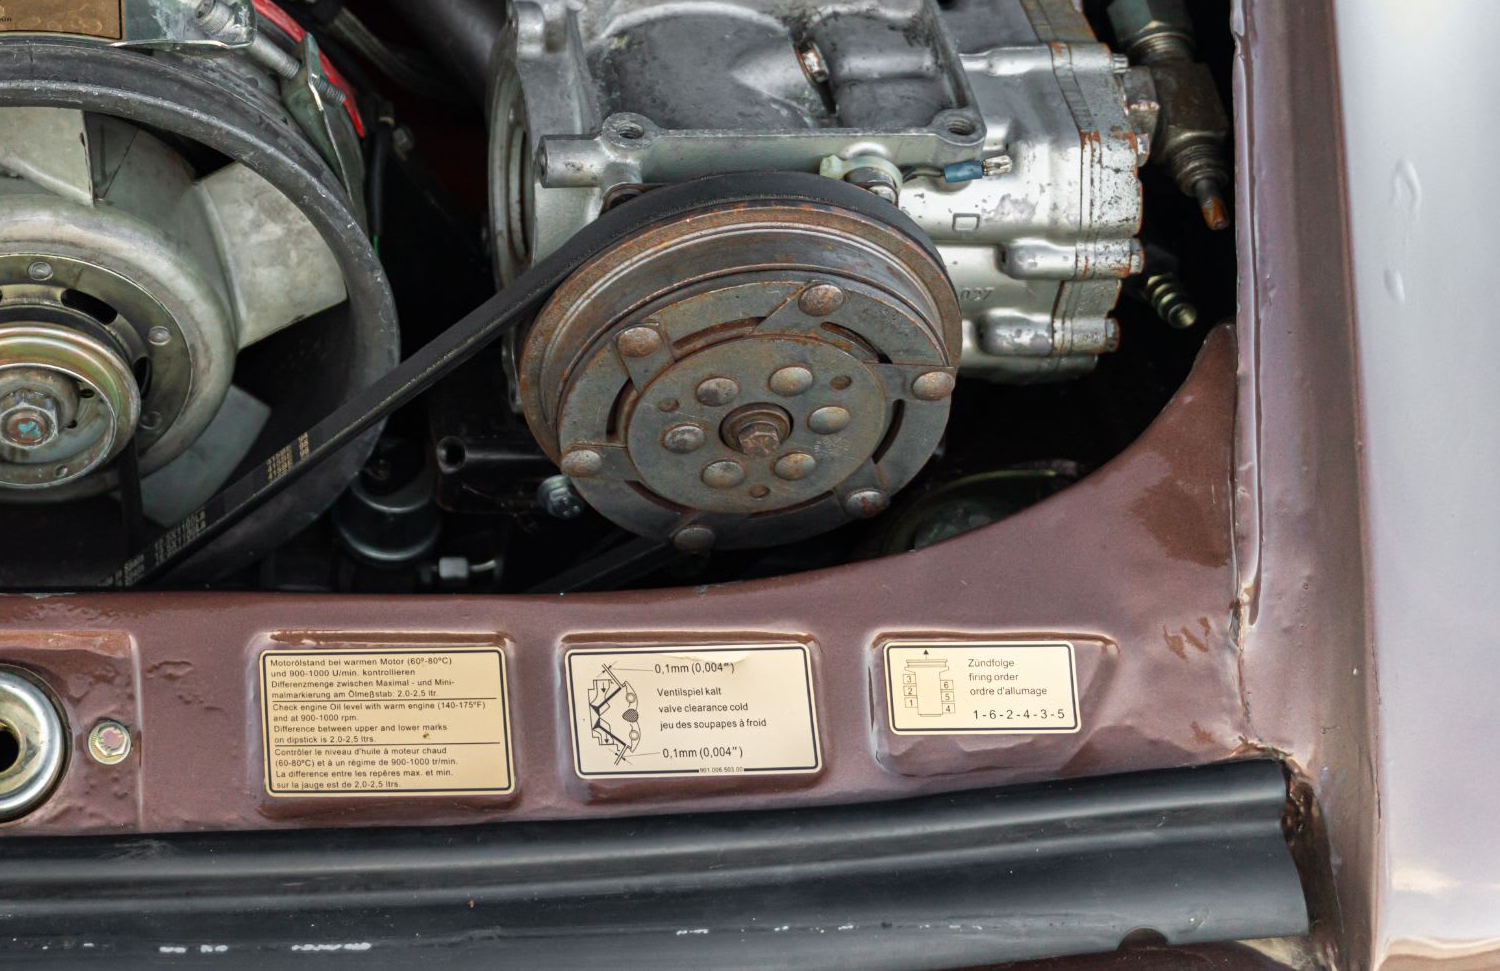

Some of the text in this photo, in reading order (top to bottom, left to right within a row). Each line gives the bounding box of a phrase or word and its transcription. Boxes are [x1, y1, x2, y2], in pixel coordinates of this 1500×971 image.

[270, 659, 326, 667] Motorölstand
[968, 659, 1014, 668] Zündfolge
[290, 669, 330, 677] 900-1000
[363, 668, 415, 676] kontrollieren
[654, 663, 689, 675] 0,1mm
[969, 673, 1018, 682] firing order
[271, 680, 334, 689] Differenzmenge
[337, 679, 373, 687] zwischen
[376, 679, 409, 687] Maximal
[417, 679, 433, 687] und
[435, 678, 455, 686] Mini-
[272, 690, 330, 700] malmarkierung
[657, 687, 721, 697] Ventilspiel kalt
[908, 687, 913, 695] 2
[997, 687, 1047, 696] d'allumage
[945, 693, 950, 701] 5
[273, 703, 298, 711] Check
[301, 702, 328, 712] engine
[330, 702, 341, 710] Oil
[343, 702, 363, 710] level
[365, 702, 382, 710] with
[384, 702, 405, 710] warm
[408, 702, 435, 710] engine
[659, 703, 748, 713] valve clearance cold
[274, 725, 315, 733] Difference
[355, 725, 378, 734] upper
[660, 719, 767, 731] jeu des soupapes à froid
[287, 735, 318, 744] dipstick
[320, 735, 327, 743] is
[275, 747, 312, 755] Contrôler
[325, 747, 352, 755] niveau
[356, 747, 381, 755] d'huile
[383, 747, 389, 755] à
[391, 747, 420, 755] moteur
[662, 748, 697, 759] 0,1mm
[391, 758, 429, 766] 900-1000
[356, 769, 367, 777] les
[277, 781, 289, 789] sur
[291, 781, 299, 789] la
[301, 781, 324, 790] jauge
[327, 780, 339, 788] est
[341, 780, 352, 788] de
